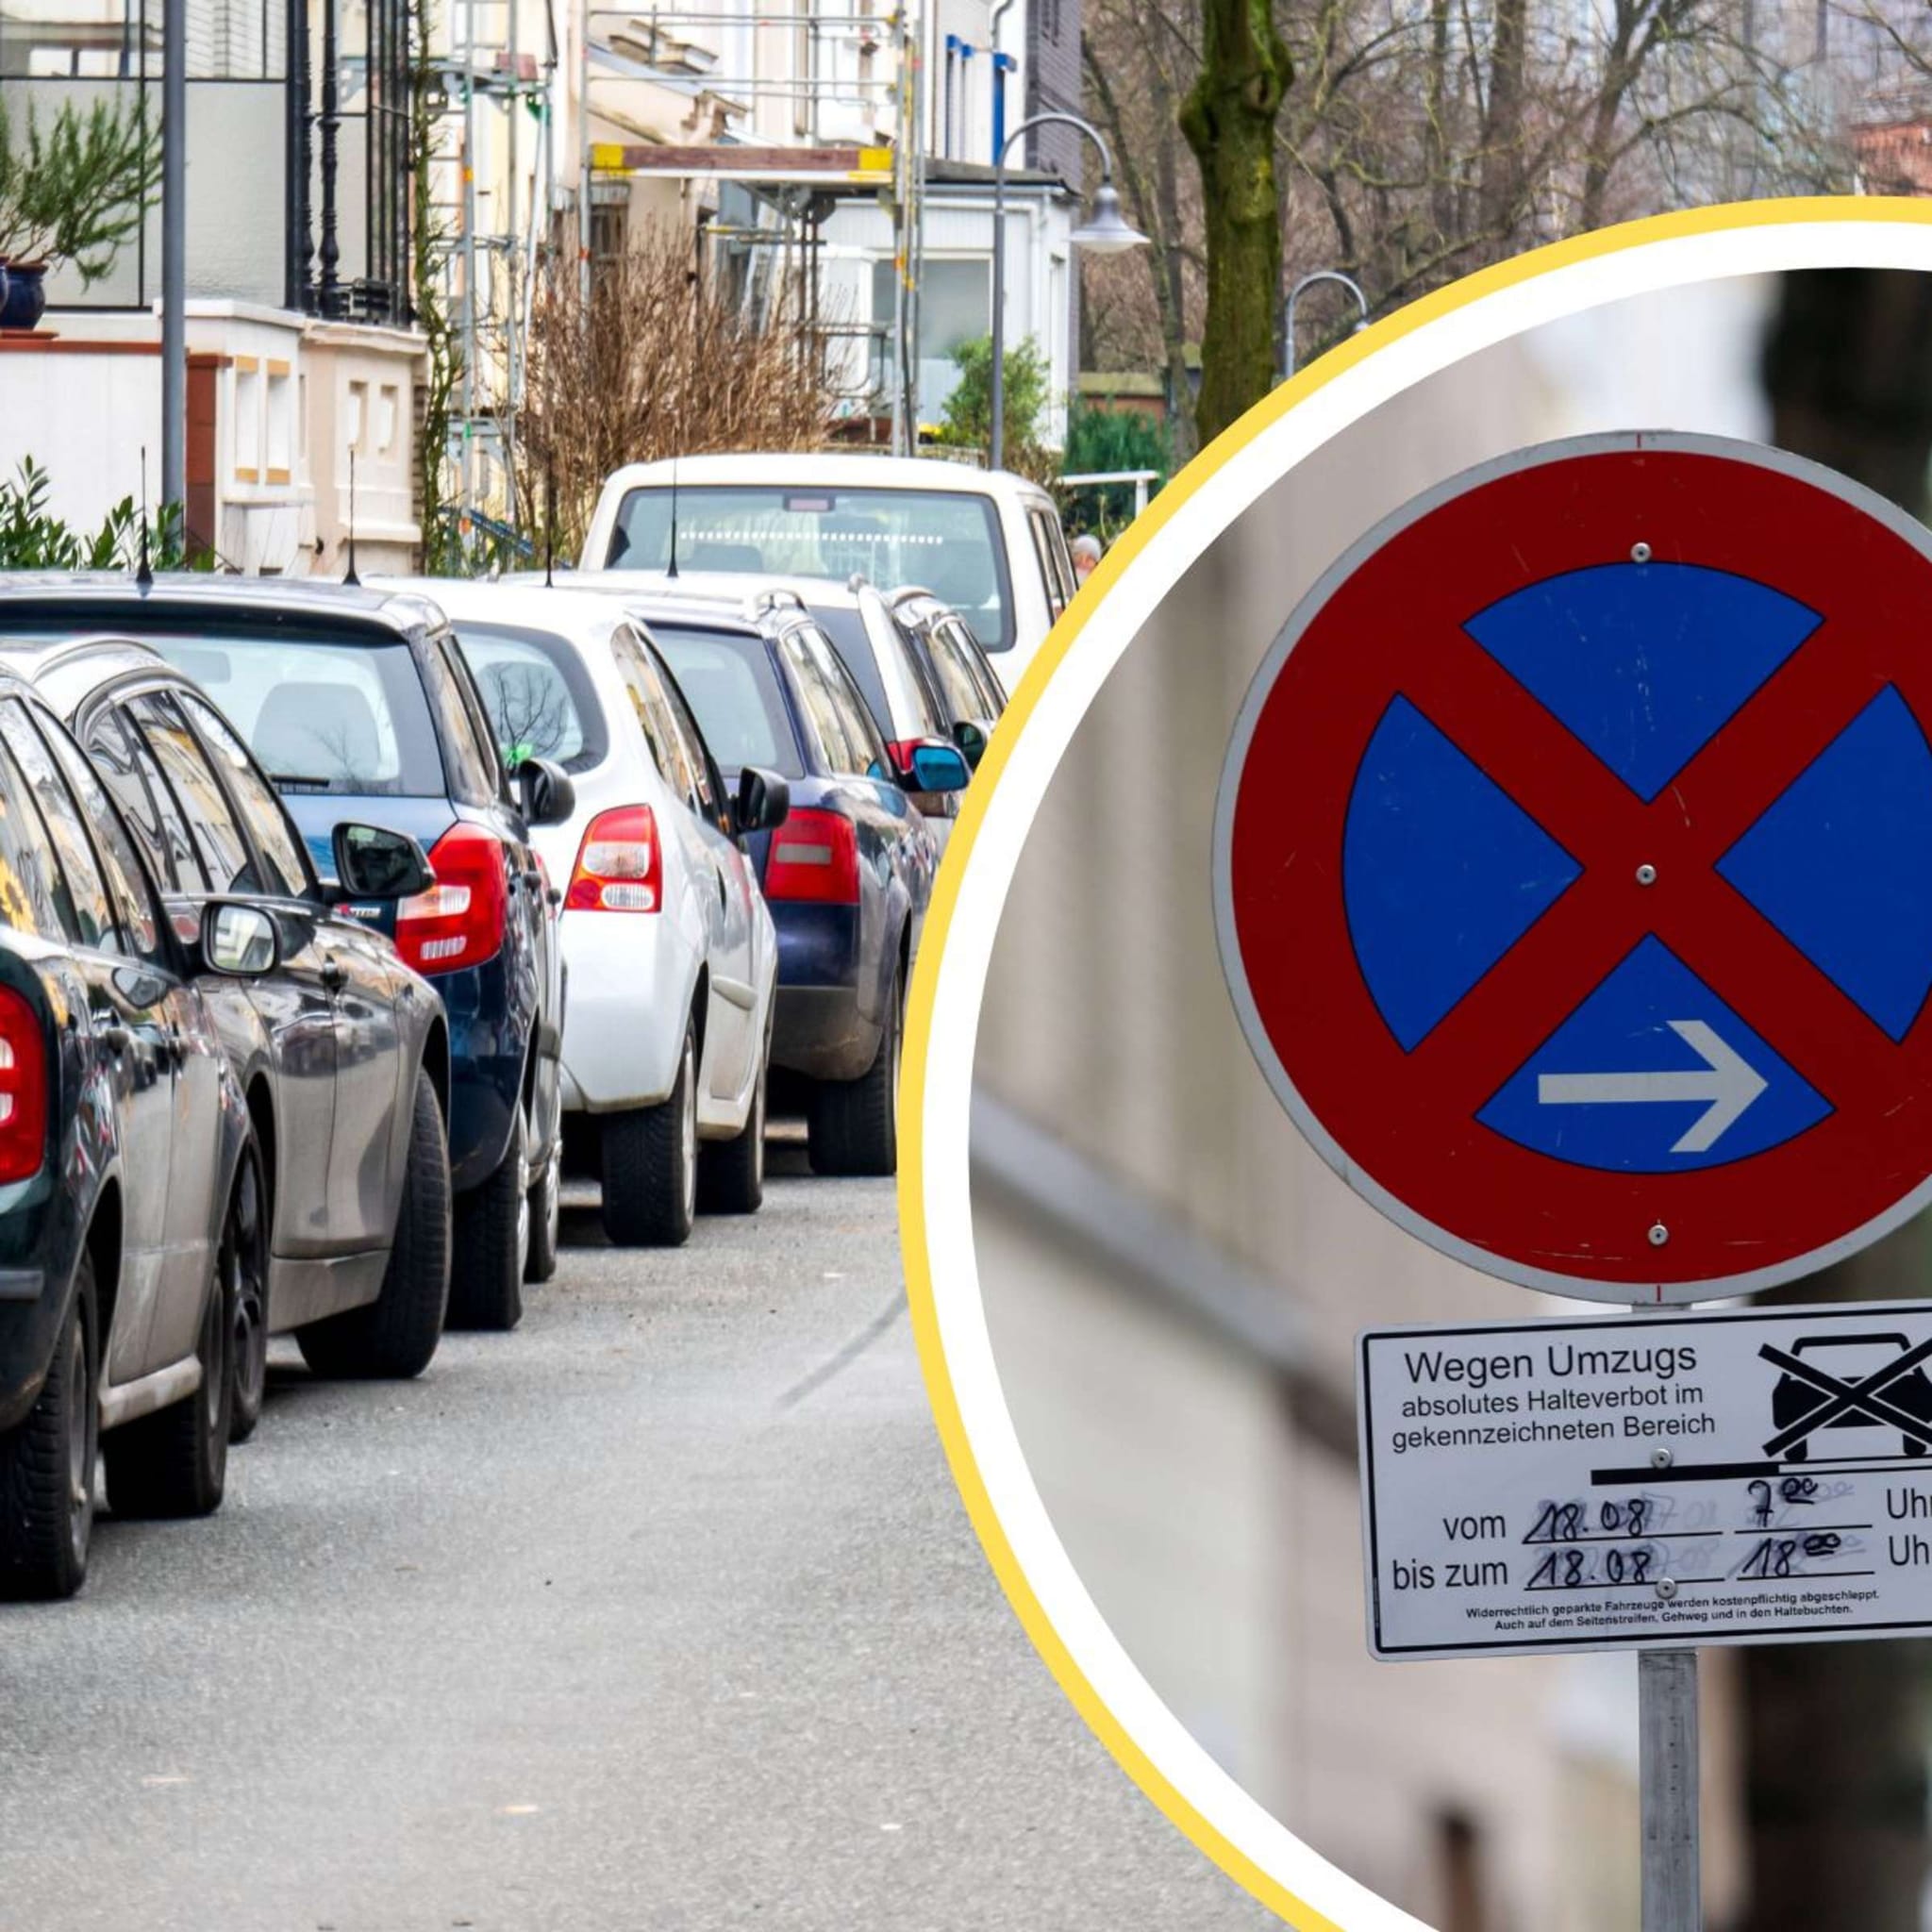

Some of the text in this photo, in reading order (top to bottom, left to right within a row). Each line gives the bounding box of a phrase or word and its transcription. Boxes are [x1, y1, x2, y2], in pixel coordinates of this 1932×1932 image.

[1405, 1345, 1697, 1389] Wegen Umzugs
[1402, 1383, 1704, 1417] absolutes Halteverbot im
[1392, 1413, 1715, 1454] gekennzeichneten Bereich
[1442, 1515, 1506, 1541] vom
[1887, 1488, 1932, 1519] Uh
[1392, 1558, 1435, 1591] bis
[1445, 1560, 1508, 1588] zum
[1889, 1534, 1930, 1566] Uh
[1466, 1590, 1879, 1618] Widerrechtlich geparkte Fahrzeuge werden kostenpflichtig abgeschleppt.
[1494, 1620, 1525, 1630] Auch
[1528, 1618, 1546, 1628] auf
[1548, 1617, 1574, 1627] dem
[1661, 1611, 1708, 1623] Gehweg
[1711, 1608, 1734, 1620] und
[1737, 1607, 1747, 1618] in
[1750, 1607, 1772, 1618] den
[1774, 1604, 1853, 1616] Haltebuchten.
